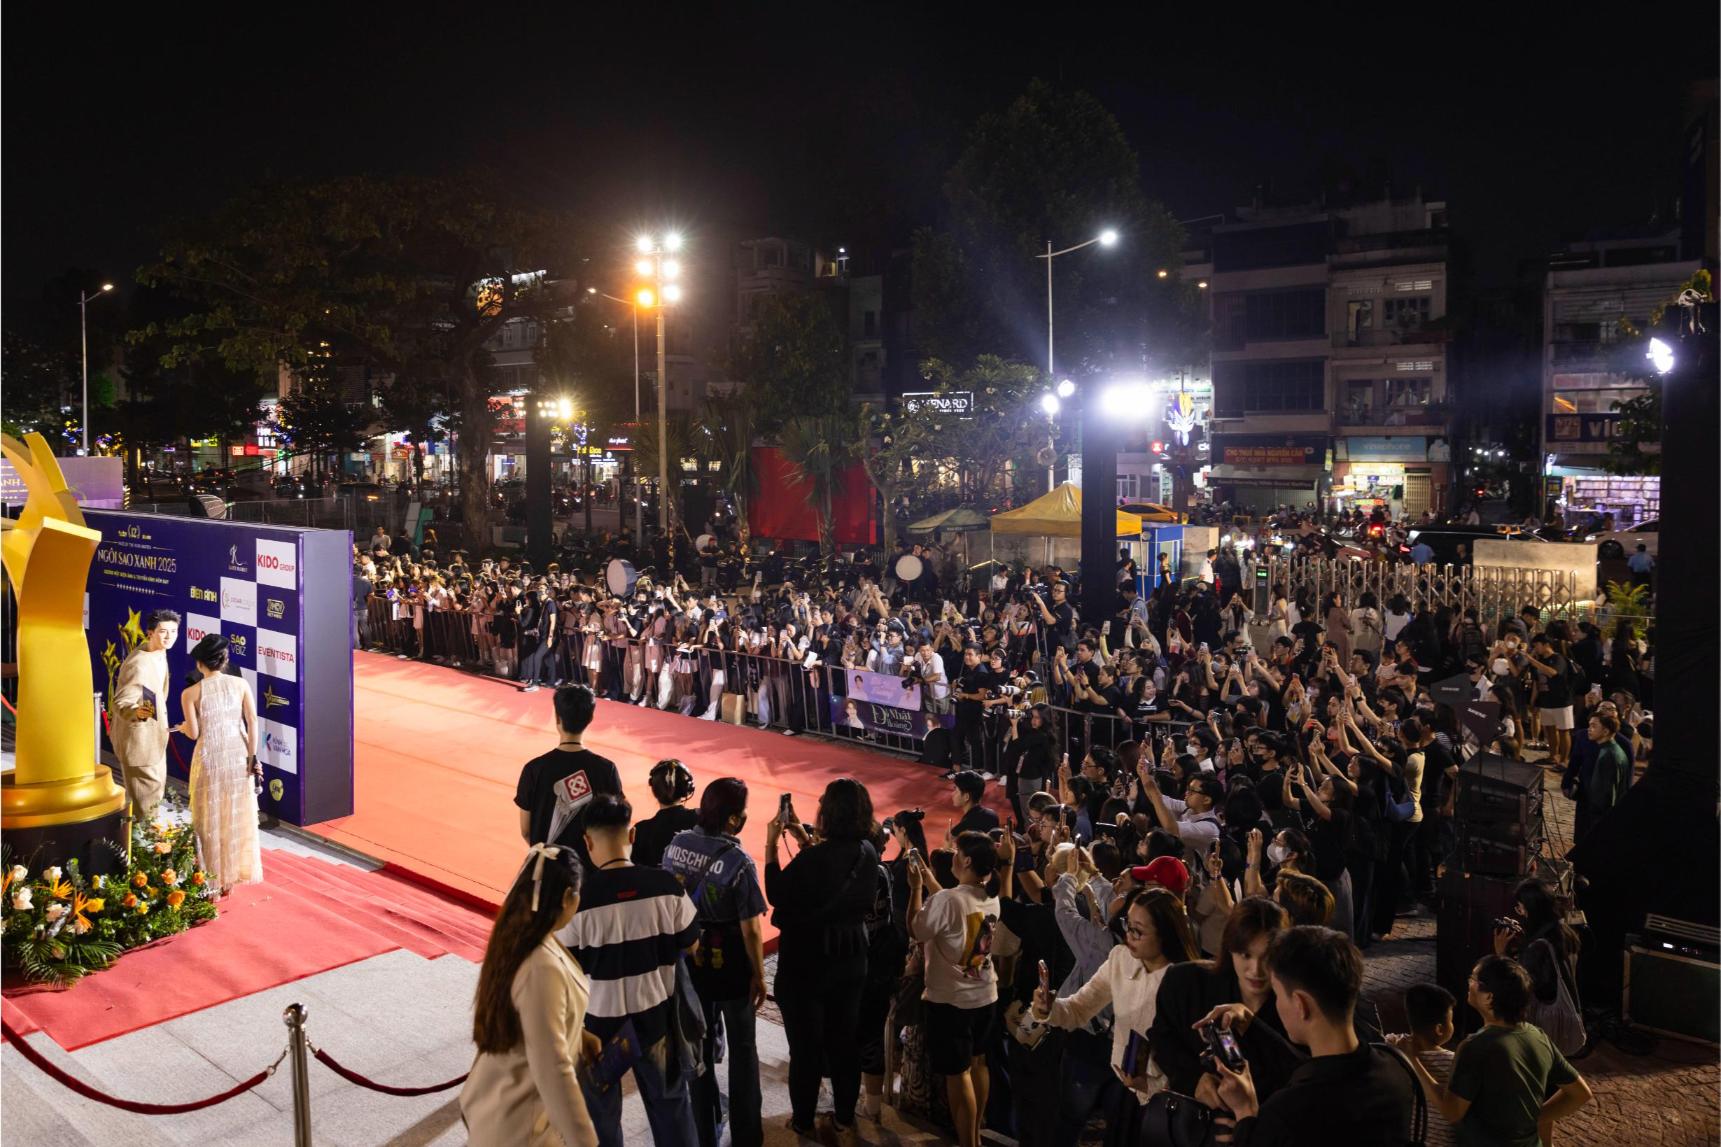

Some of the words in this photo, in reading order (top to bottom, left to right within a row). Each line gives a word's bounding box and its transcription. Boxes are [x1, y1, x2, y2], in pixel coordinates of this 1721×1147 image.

[98, 547, 118, 564] NGÔI
[119, 551, 134, 567] SAO
[134, 554, 157, 571] XANH
[158, 557, 177, 573] 2025
[257, 553, 279, 570] KIDO
[230, 633, 246, 646] SAO
[258, 646, 295, 663] EVENTISTA
